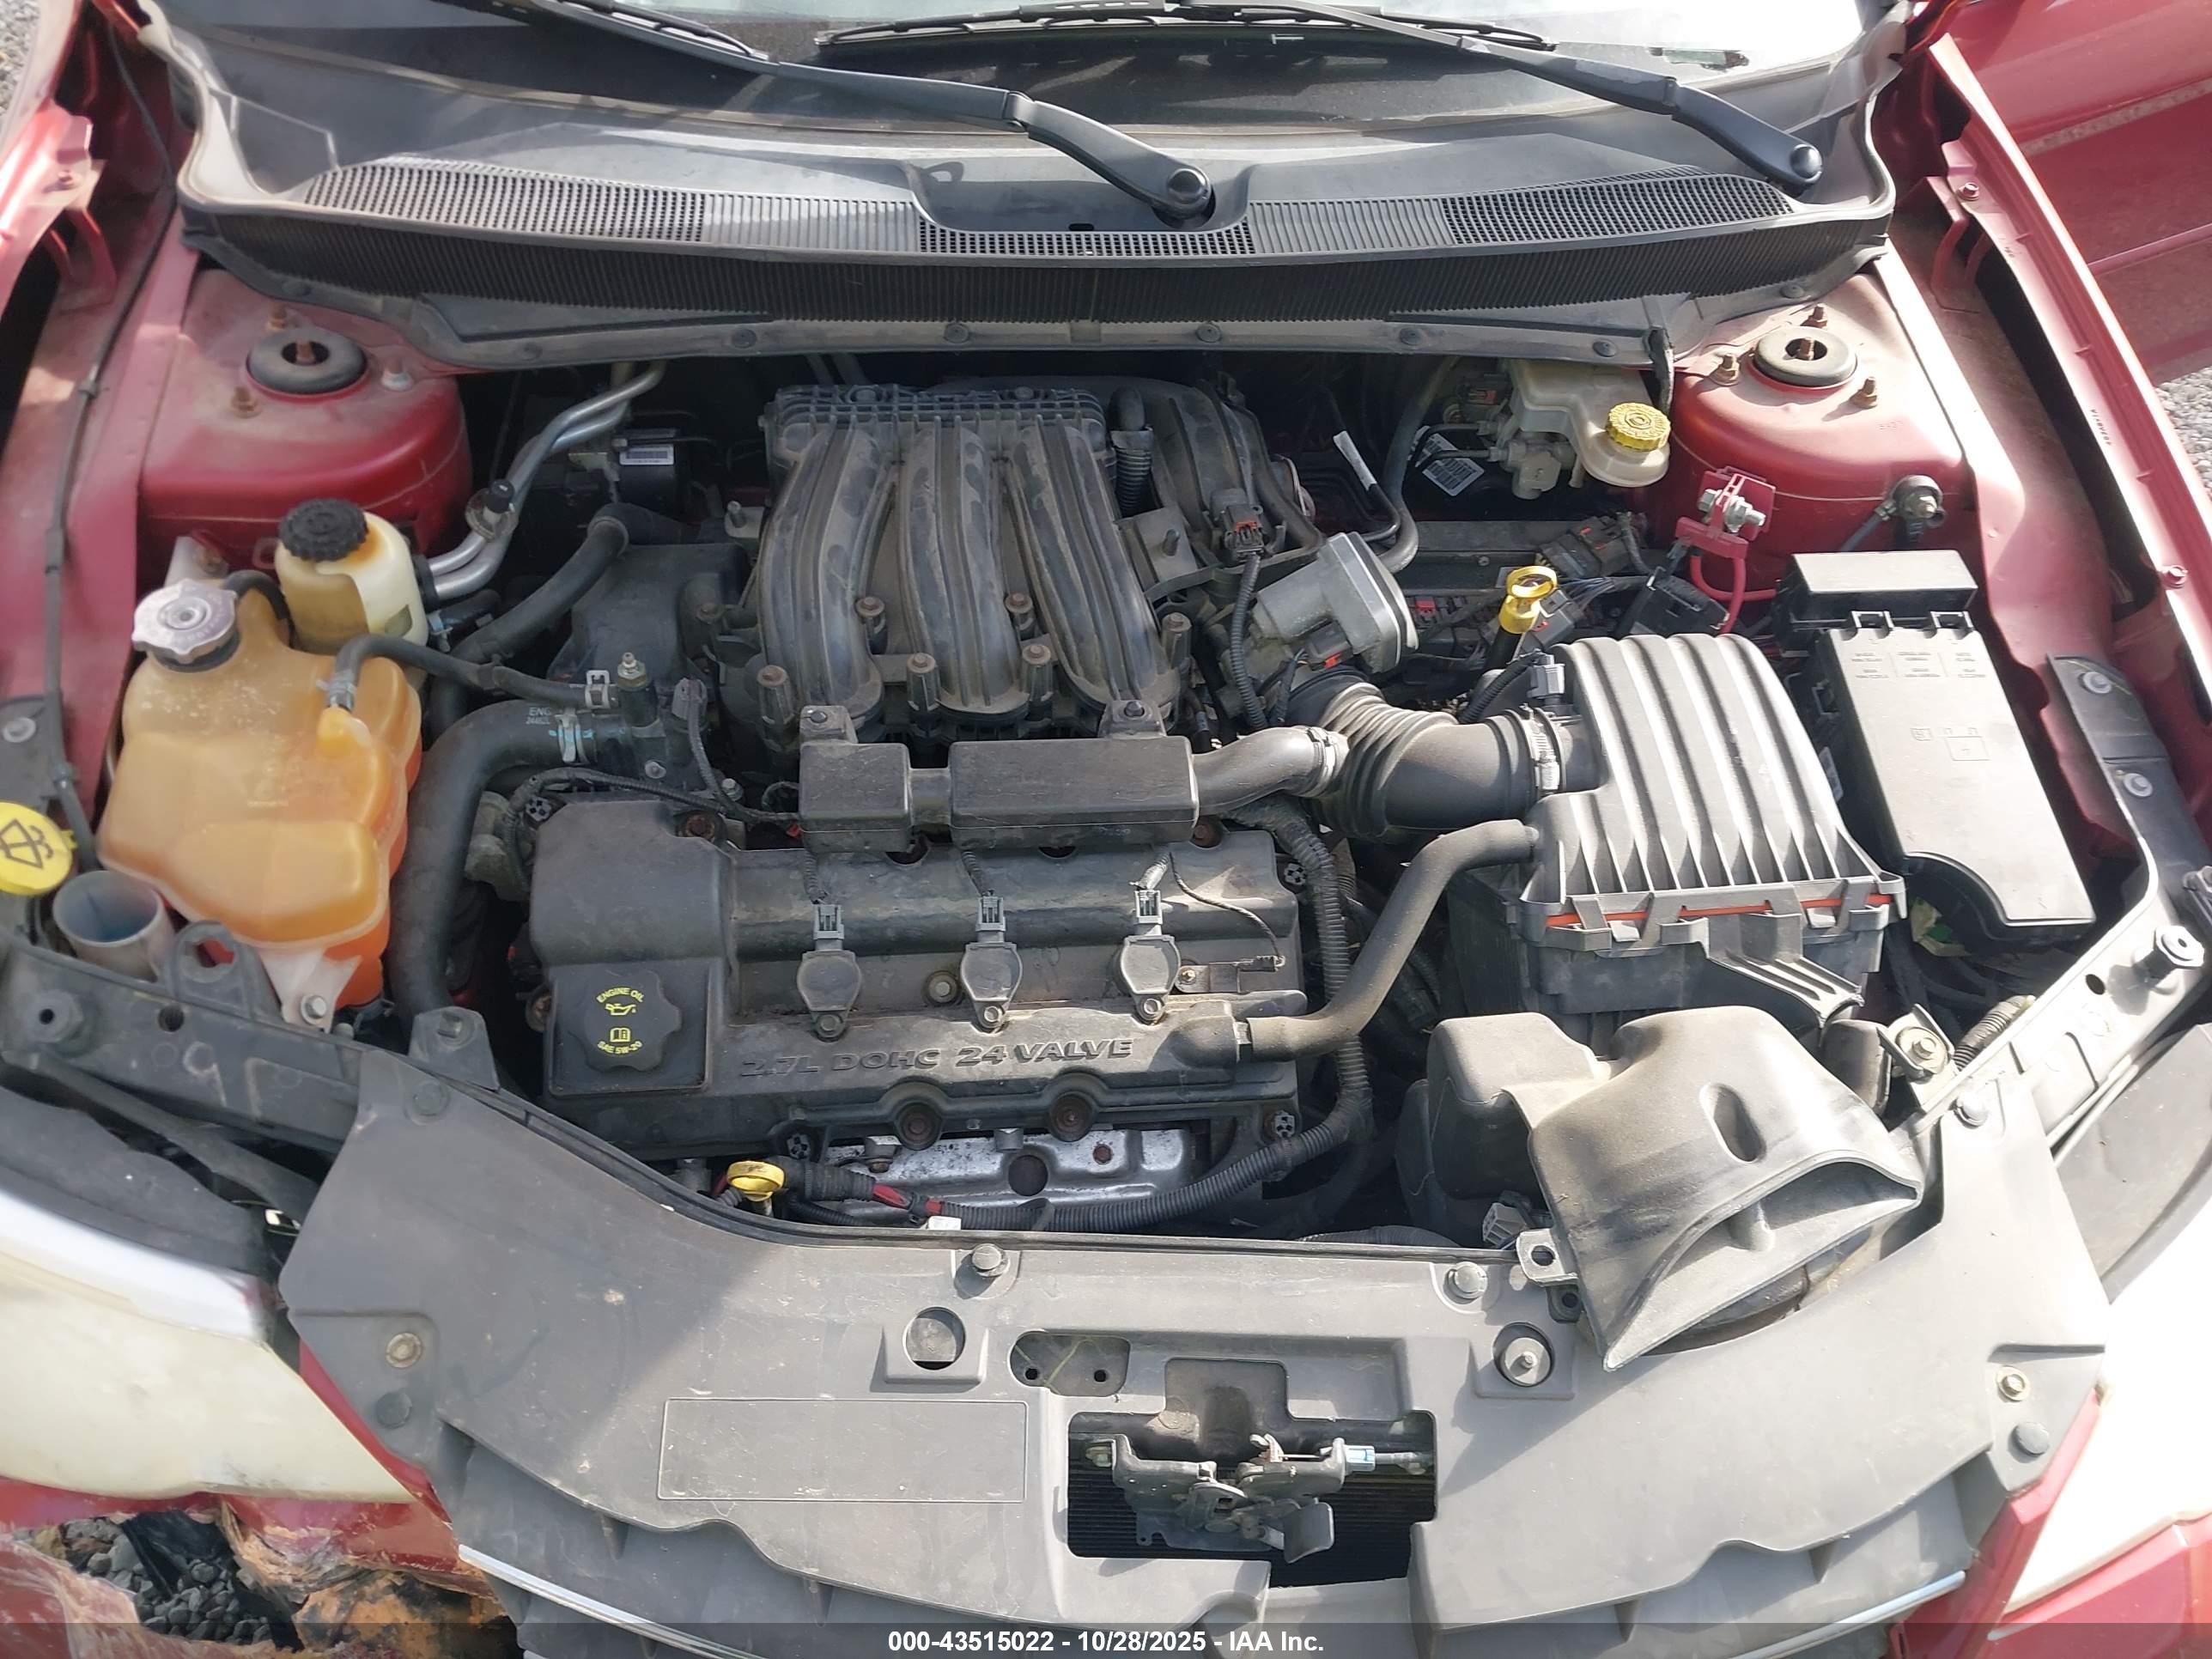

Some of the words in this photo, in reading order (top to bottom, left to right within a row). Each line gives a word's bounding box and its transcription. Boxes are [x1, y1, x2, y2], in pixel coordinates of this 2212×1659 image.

[596, 988, 630, 1003] ENGINE
[630, 989, 644, 1003] OIL
[598, 1040, 615, 1054] SAE
[830, 1048, 941, 1072] DOHC
[955, 1042, 1007, 1067] 24
[1013, 1037, 1134, 1064] VALVE
